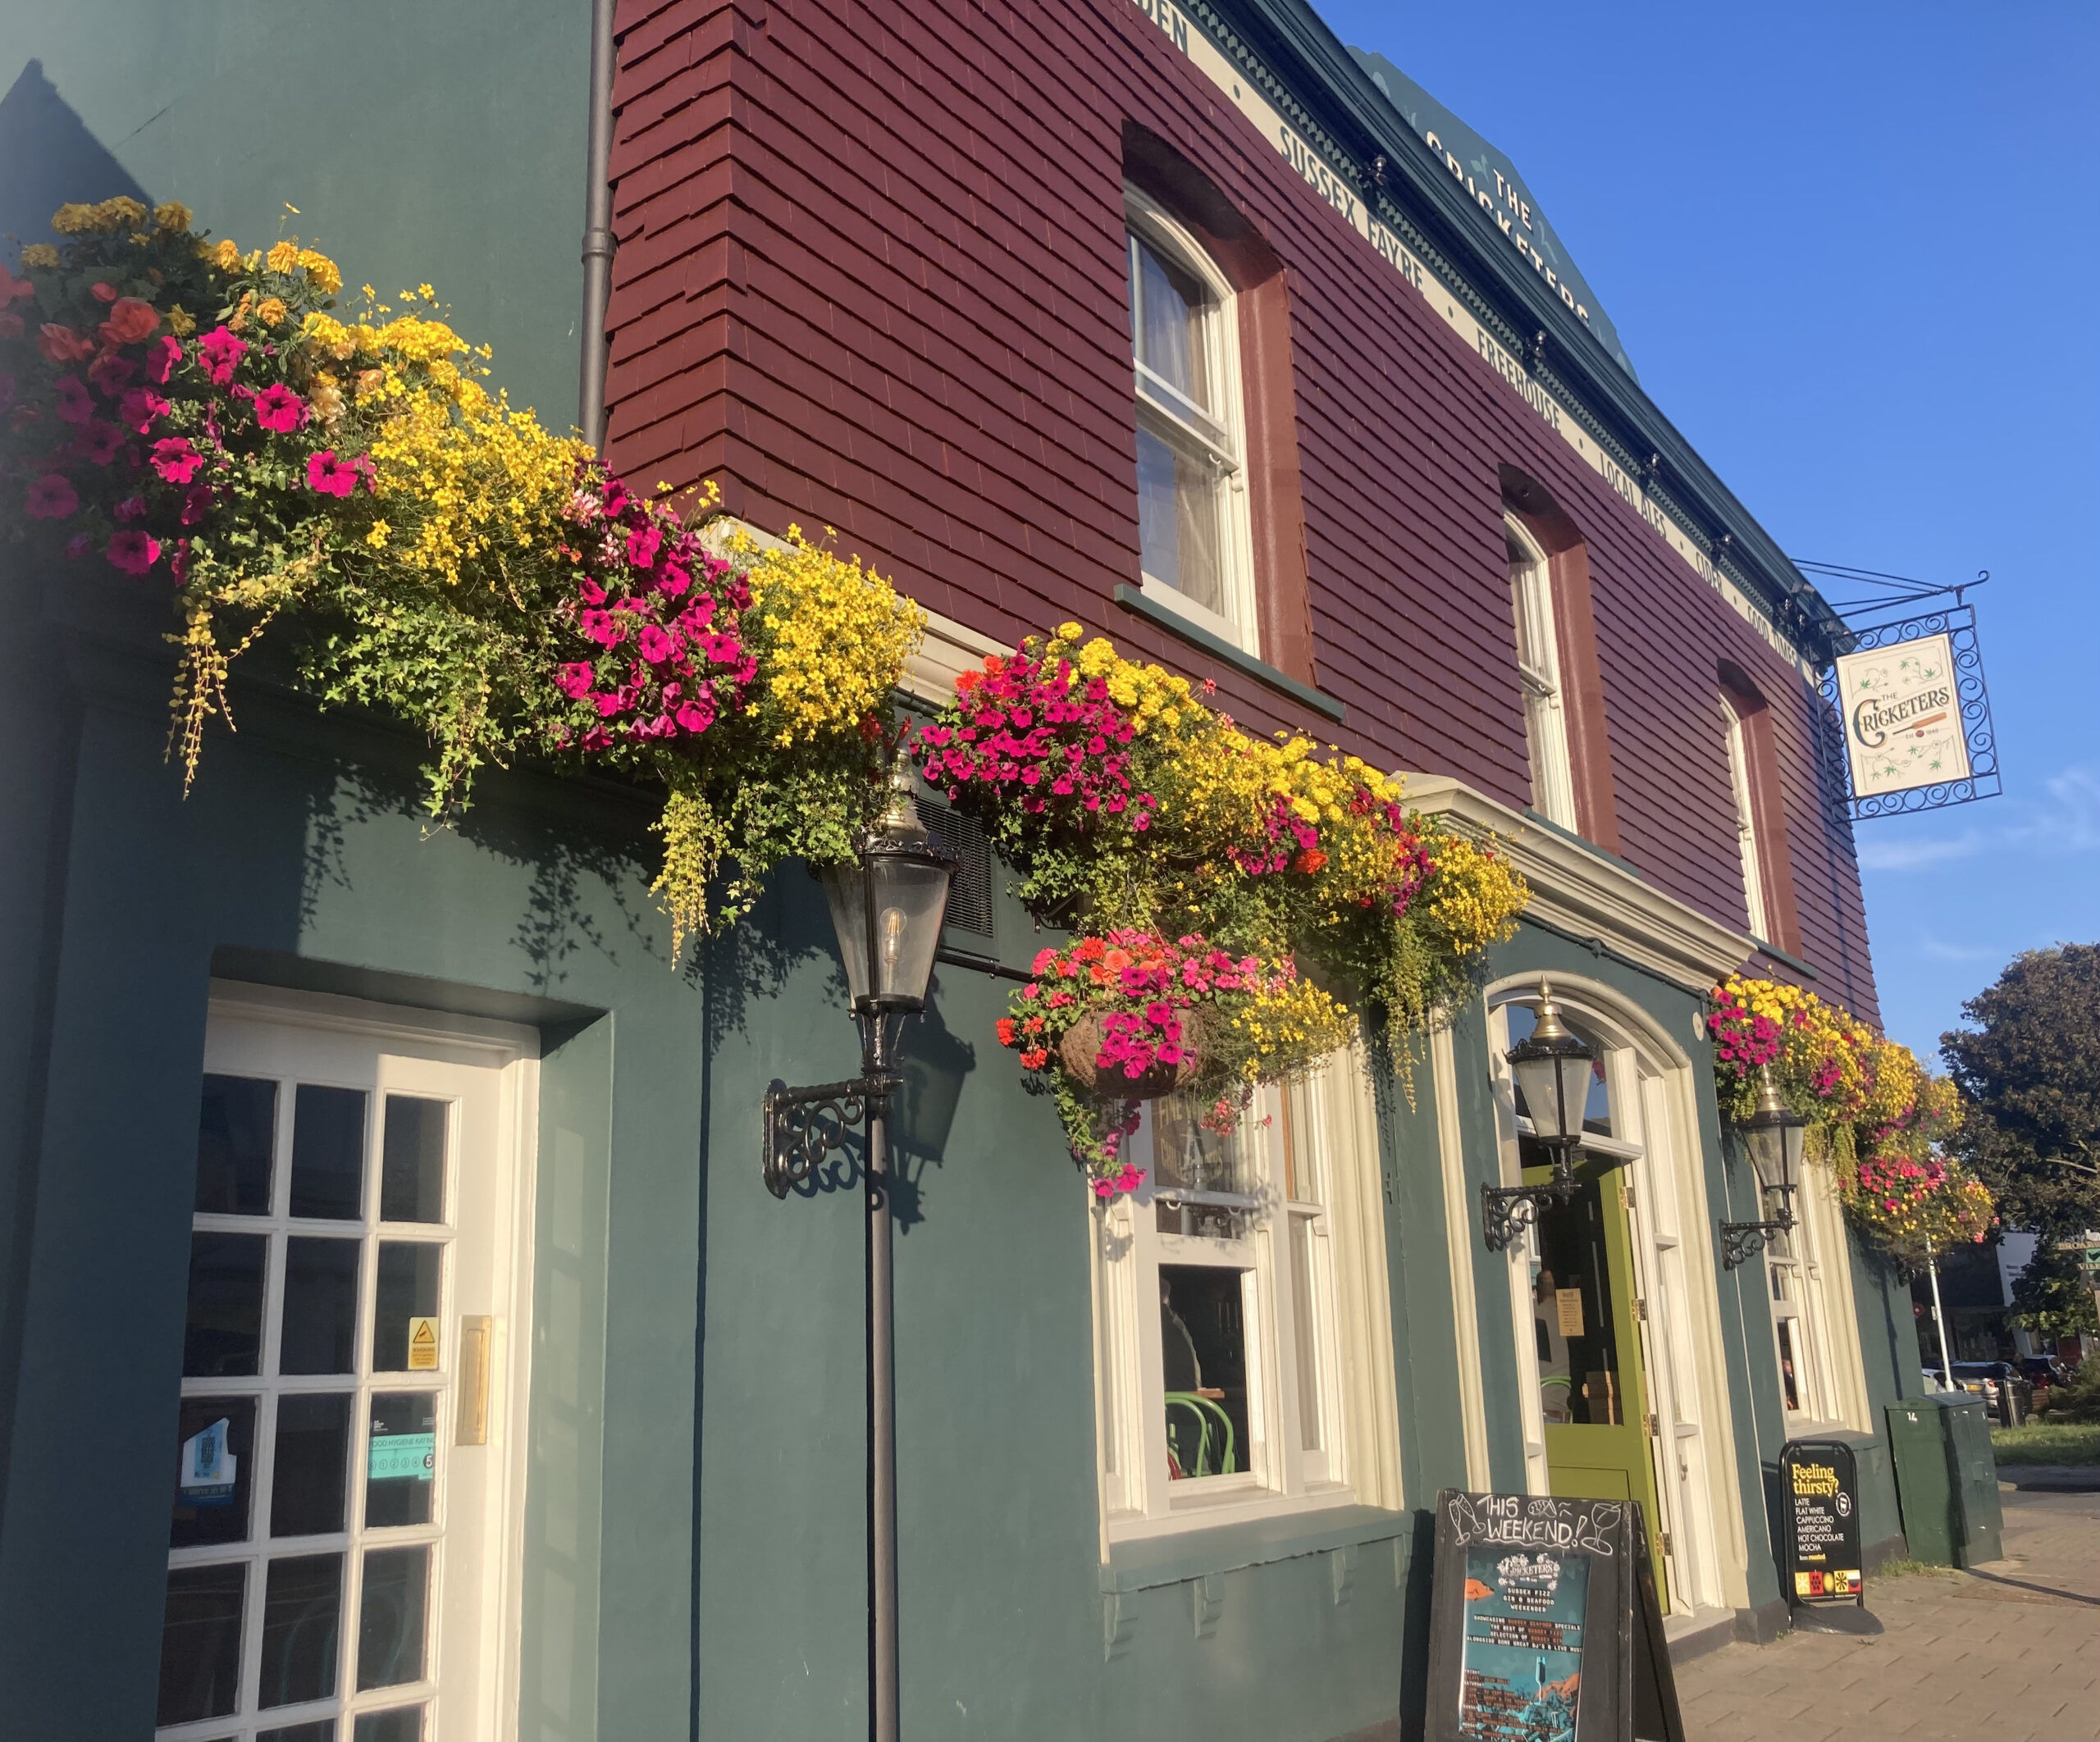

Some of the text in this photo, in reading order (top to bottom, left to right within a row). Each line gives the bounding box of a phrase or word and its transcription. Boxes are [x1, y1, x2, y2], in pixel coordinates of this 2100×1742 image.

[1493, 167, 1533, 232] THE
[1280, 125, 1357, 230] SUSSEX
[1367, 212, 1424, 294] FAYRE
[1477, 326, 1562, 432] FREEHOUSE
[1600, 452, 1637, 509] LOCAL
[1641, 492, 1667, 540] ALES
[1695, 551, 1724, 597] CIDER
[1746, 605, 1769, 641] GOOD
[1880, 691, 1898, 701] THE
[1852, 686, 1950, 749] CRICKETERS
[1907, 1411, 1918, 1422] 14
[425, 1455, 433, 1468] 5
[1792, 1463, 1834, 1482] Feeling
[1793, 1478, 1839, 1498] thirsty?
[1477, 1494, 1519, 1517] THIS
[1794, 1498, 1810, 1506] LATTE
[1796, 1516, 1834, 1524] CAPPUCCINO
[1487, 1516, 1587, 1548] WEEKEND!
[1797, 1525, 1832, 1533] AMERICANO
[1810, 1533, 1844, 1542] CHOCOLATE
[1527, 1597, 1554, 1605] SEAFOOD
[1511, 1604, 1546, 1612] WEEKENDER
